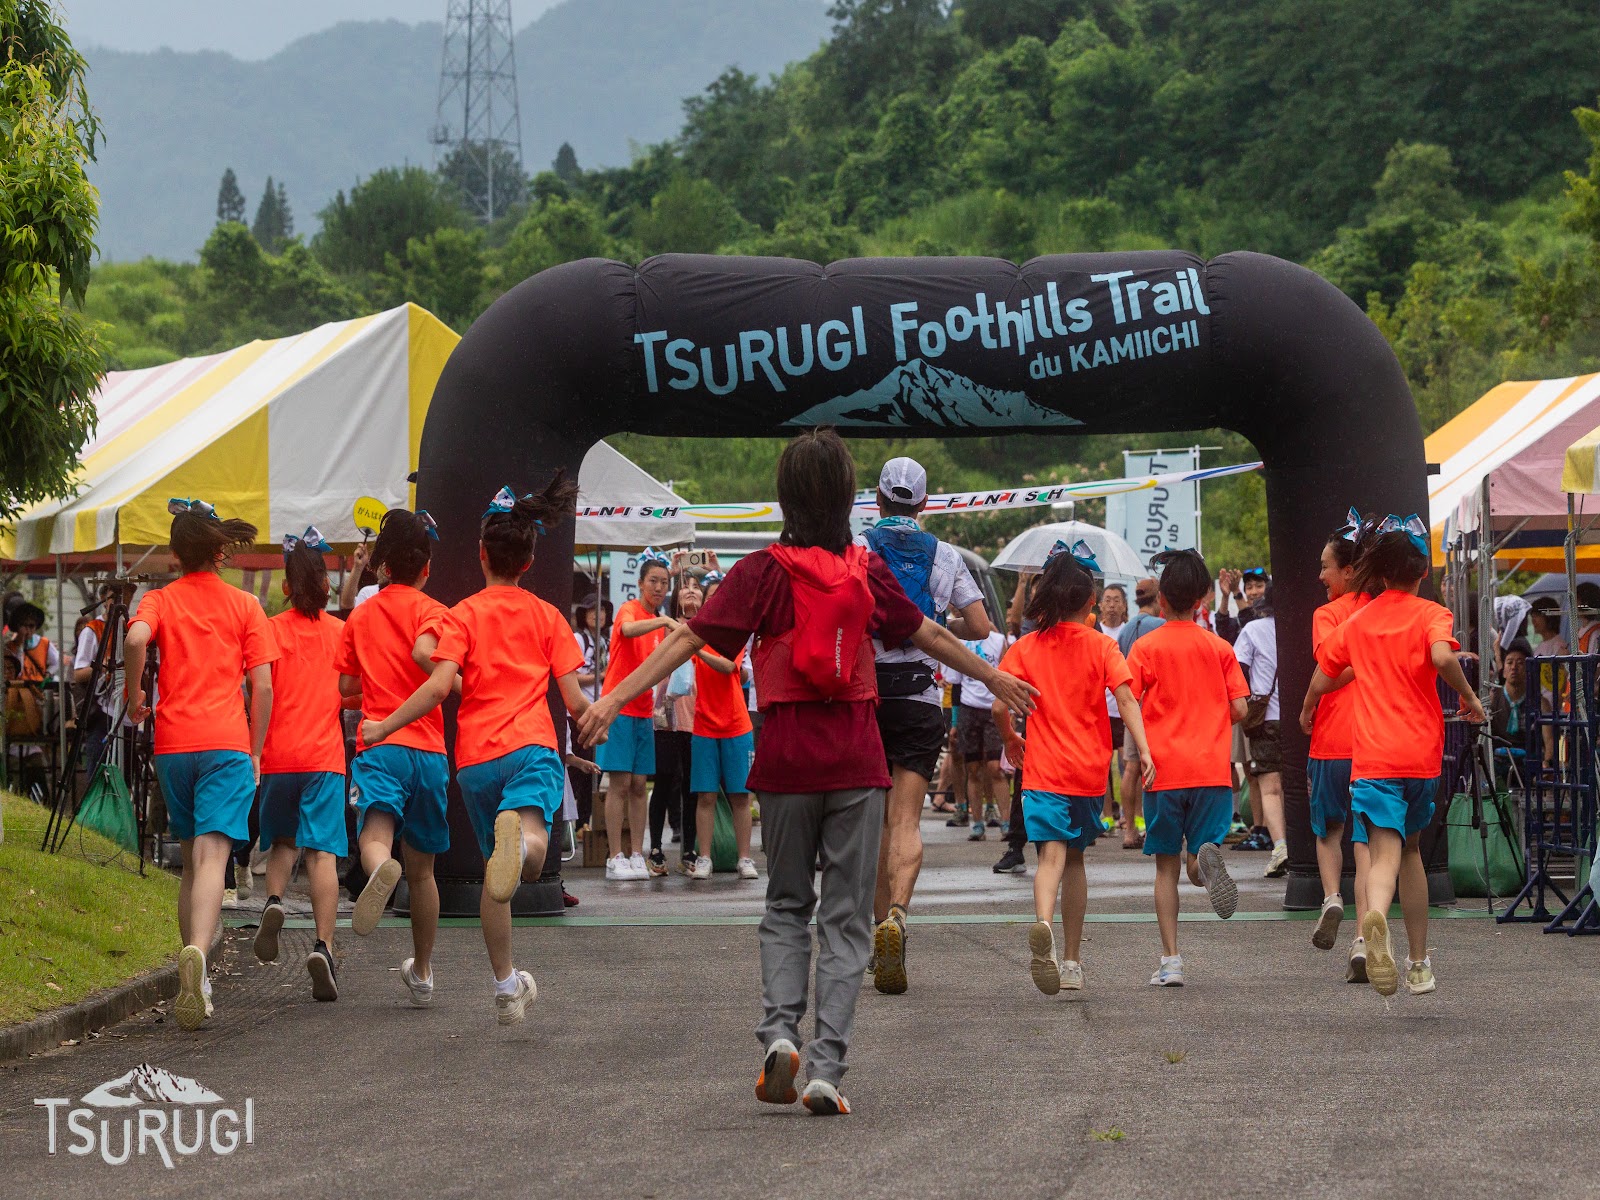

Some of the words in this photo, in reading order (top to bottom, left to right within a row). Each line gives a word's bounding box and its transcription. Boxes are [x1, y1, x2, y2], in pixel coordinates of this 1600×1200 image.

[633, 305, 867, 395] TSURUGI
[890, 281, 1093, 361] Foothills
[1091, 267, 1211, 325] Trail
[1029, 351, 1061, 380] du
[1068, 319, 1201, 373] KAMIICHI
[583, 506, 679, 517] INISH
[947, 488, 1065, 508] FINISH
[835, 627, 843, 678] SALOMON
